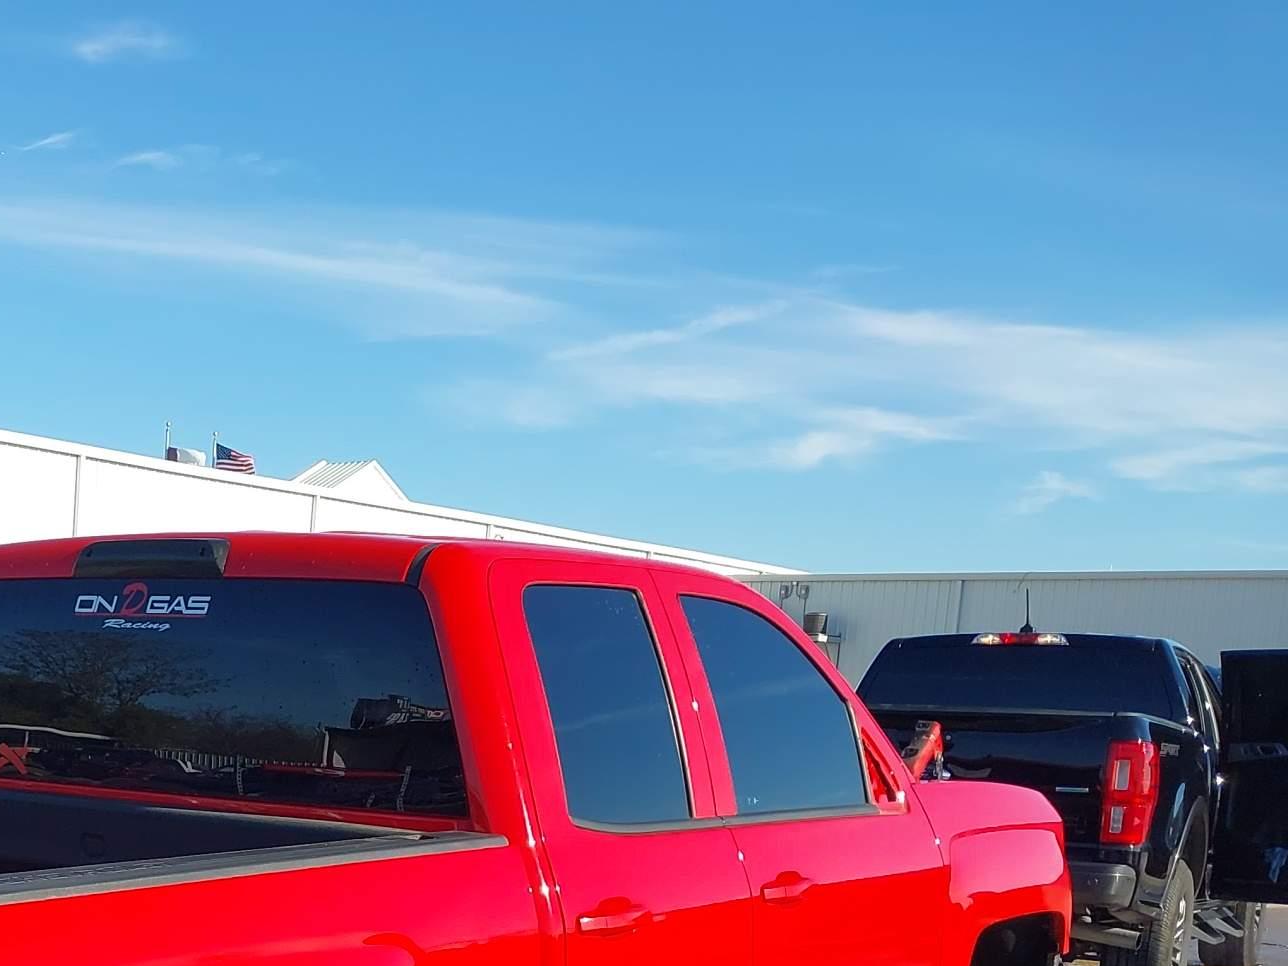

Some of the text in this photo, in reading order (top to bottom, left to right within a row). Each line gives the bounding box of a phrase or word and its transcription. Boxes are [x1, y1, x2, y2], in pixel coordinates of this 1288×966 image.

[74, 595, 118, 613] ON
[145, 595, 211, 614] GAS
[102, 618, 171, 631] Racing
